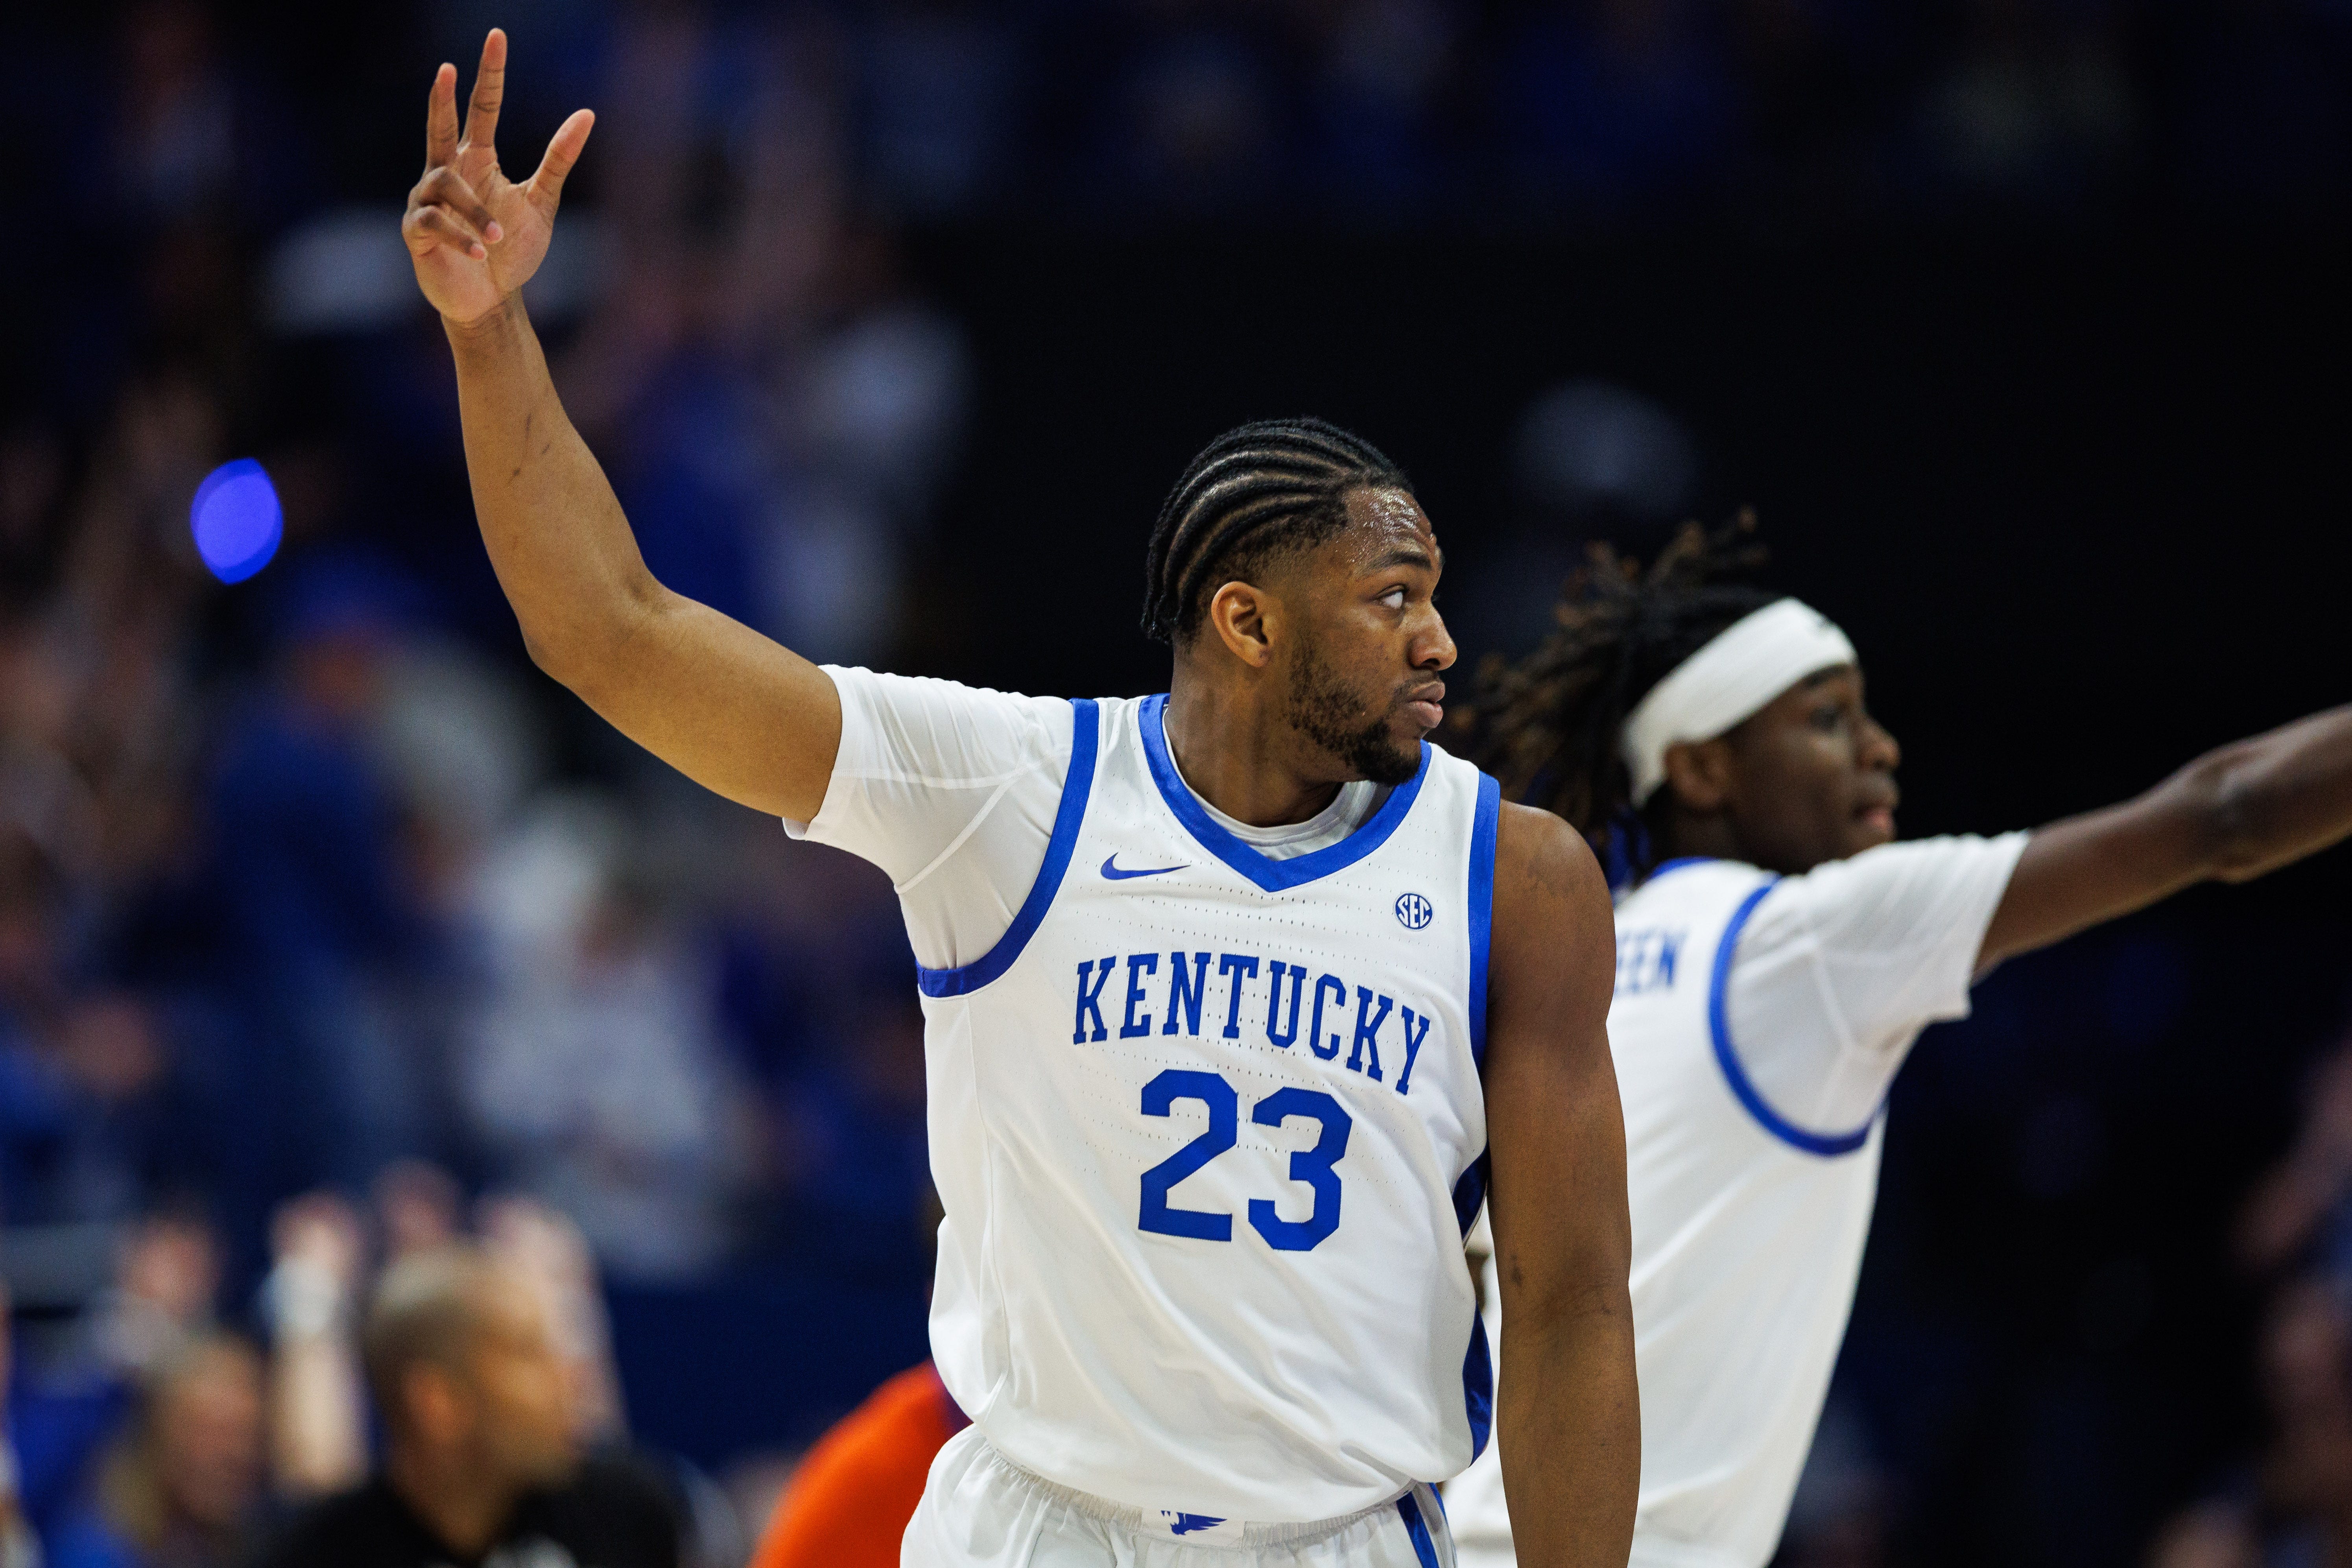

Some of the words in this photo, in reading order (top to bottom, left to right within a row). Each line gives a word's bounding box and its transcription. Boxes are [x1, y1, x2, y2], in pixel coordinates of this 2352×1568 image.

[1397, 895, 1430, 928] SEC
[1074, 951, 1430, 1095] KENTUCKY
[1138, 1068, 1352, 1252] 23
